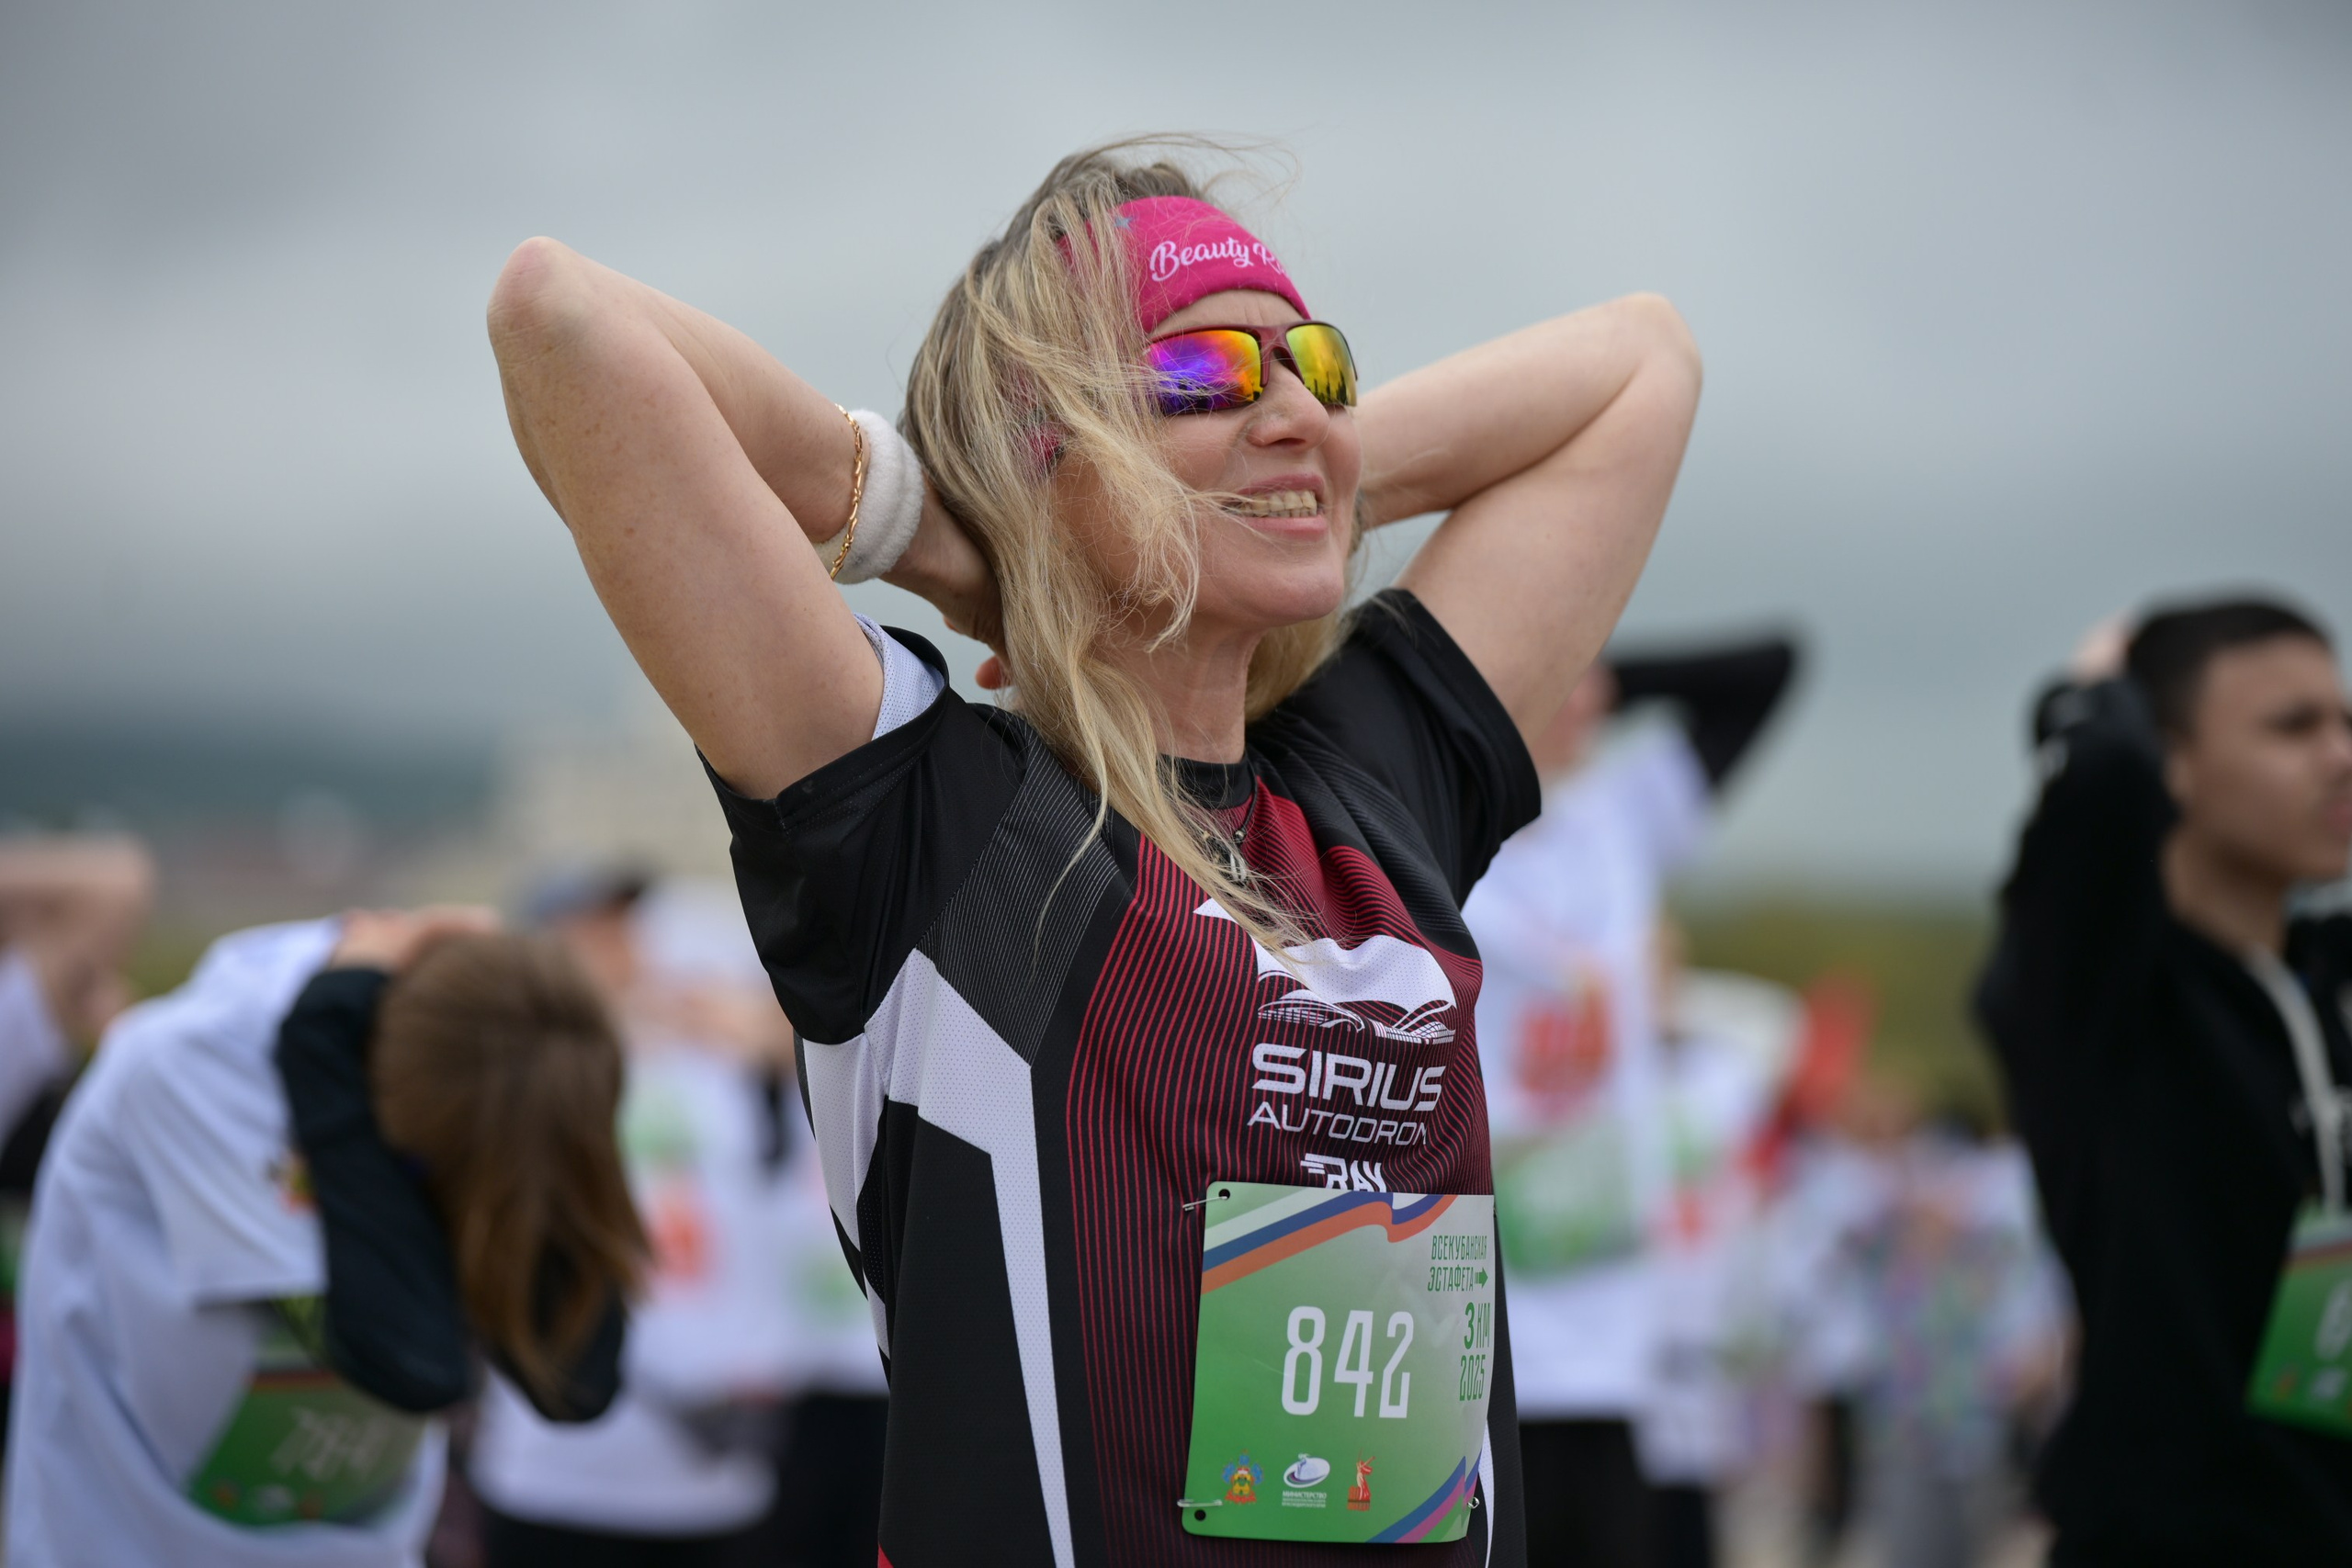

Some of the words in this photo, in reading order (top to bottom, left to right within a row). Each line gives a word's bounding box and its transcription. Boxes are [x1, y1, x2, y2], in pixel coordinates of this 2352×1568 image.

[1149, 237, 1254, 282] Beauty
[1251, 1043, 1446, 1111] SIRIUS
[1431, 1235, 1487, 1260] ВСЕКУБАНСКАЯ
[1427, 1265, 1474, 1292] ЭСТАФЕТА
[1464, 1303, 1475, 1349] 3
[1476, 1303, 1490, 1348] КМ
[1282, 1306, 1414, 1418] 842
[1459, 1354, 1486, 1402] 2025
